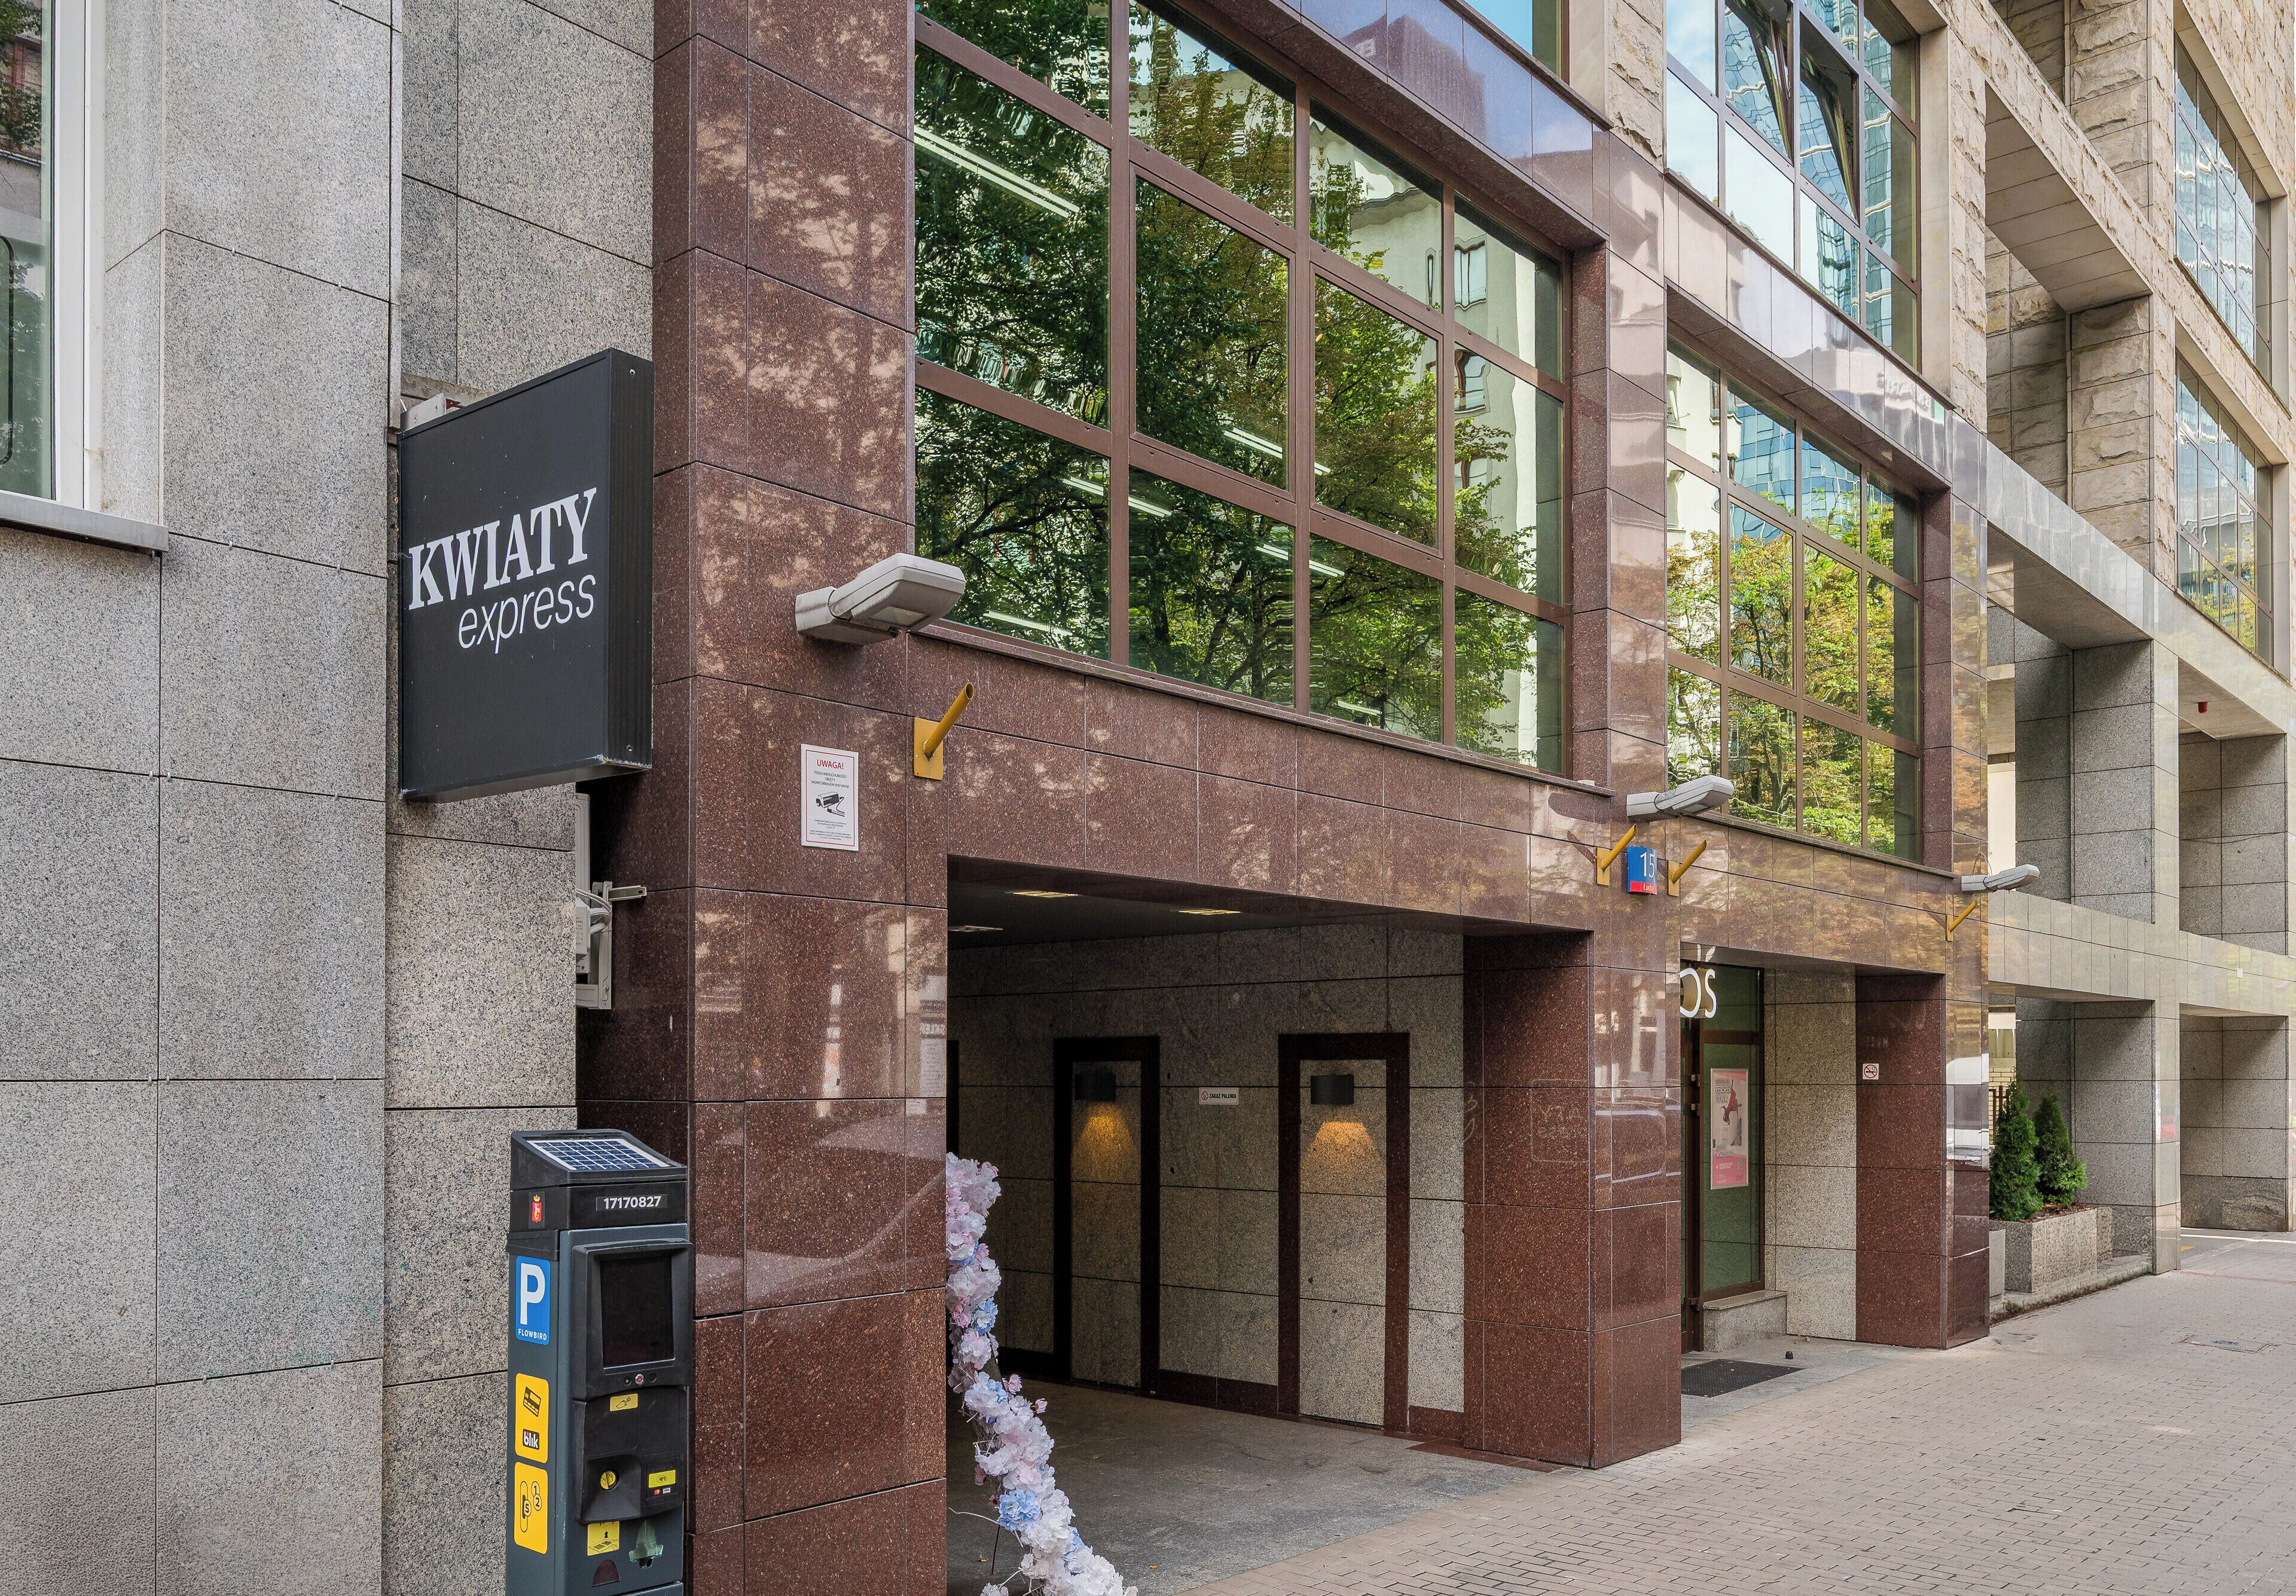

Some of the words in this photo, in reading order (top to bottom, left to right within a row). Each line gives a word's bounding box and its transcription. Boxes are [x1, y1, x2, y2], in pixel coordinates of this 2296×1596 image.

[408, 487, 597, 610] KWIATY
[459, 574, 596, 654] express
[817, 759, 844, 770] UWAGA!
[1640, 852, 1654, 878] 15
[604, 1196, 661, 1209] 17170827
[520, 1263, 545, 1325] P
[518, 1328, 547, 1341] FLOWBIRD
[524, 1431, 539, 1448] blik
[525, 1503, 529, 1513] 5
[535, 1497, 539, 1507] 2
